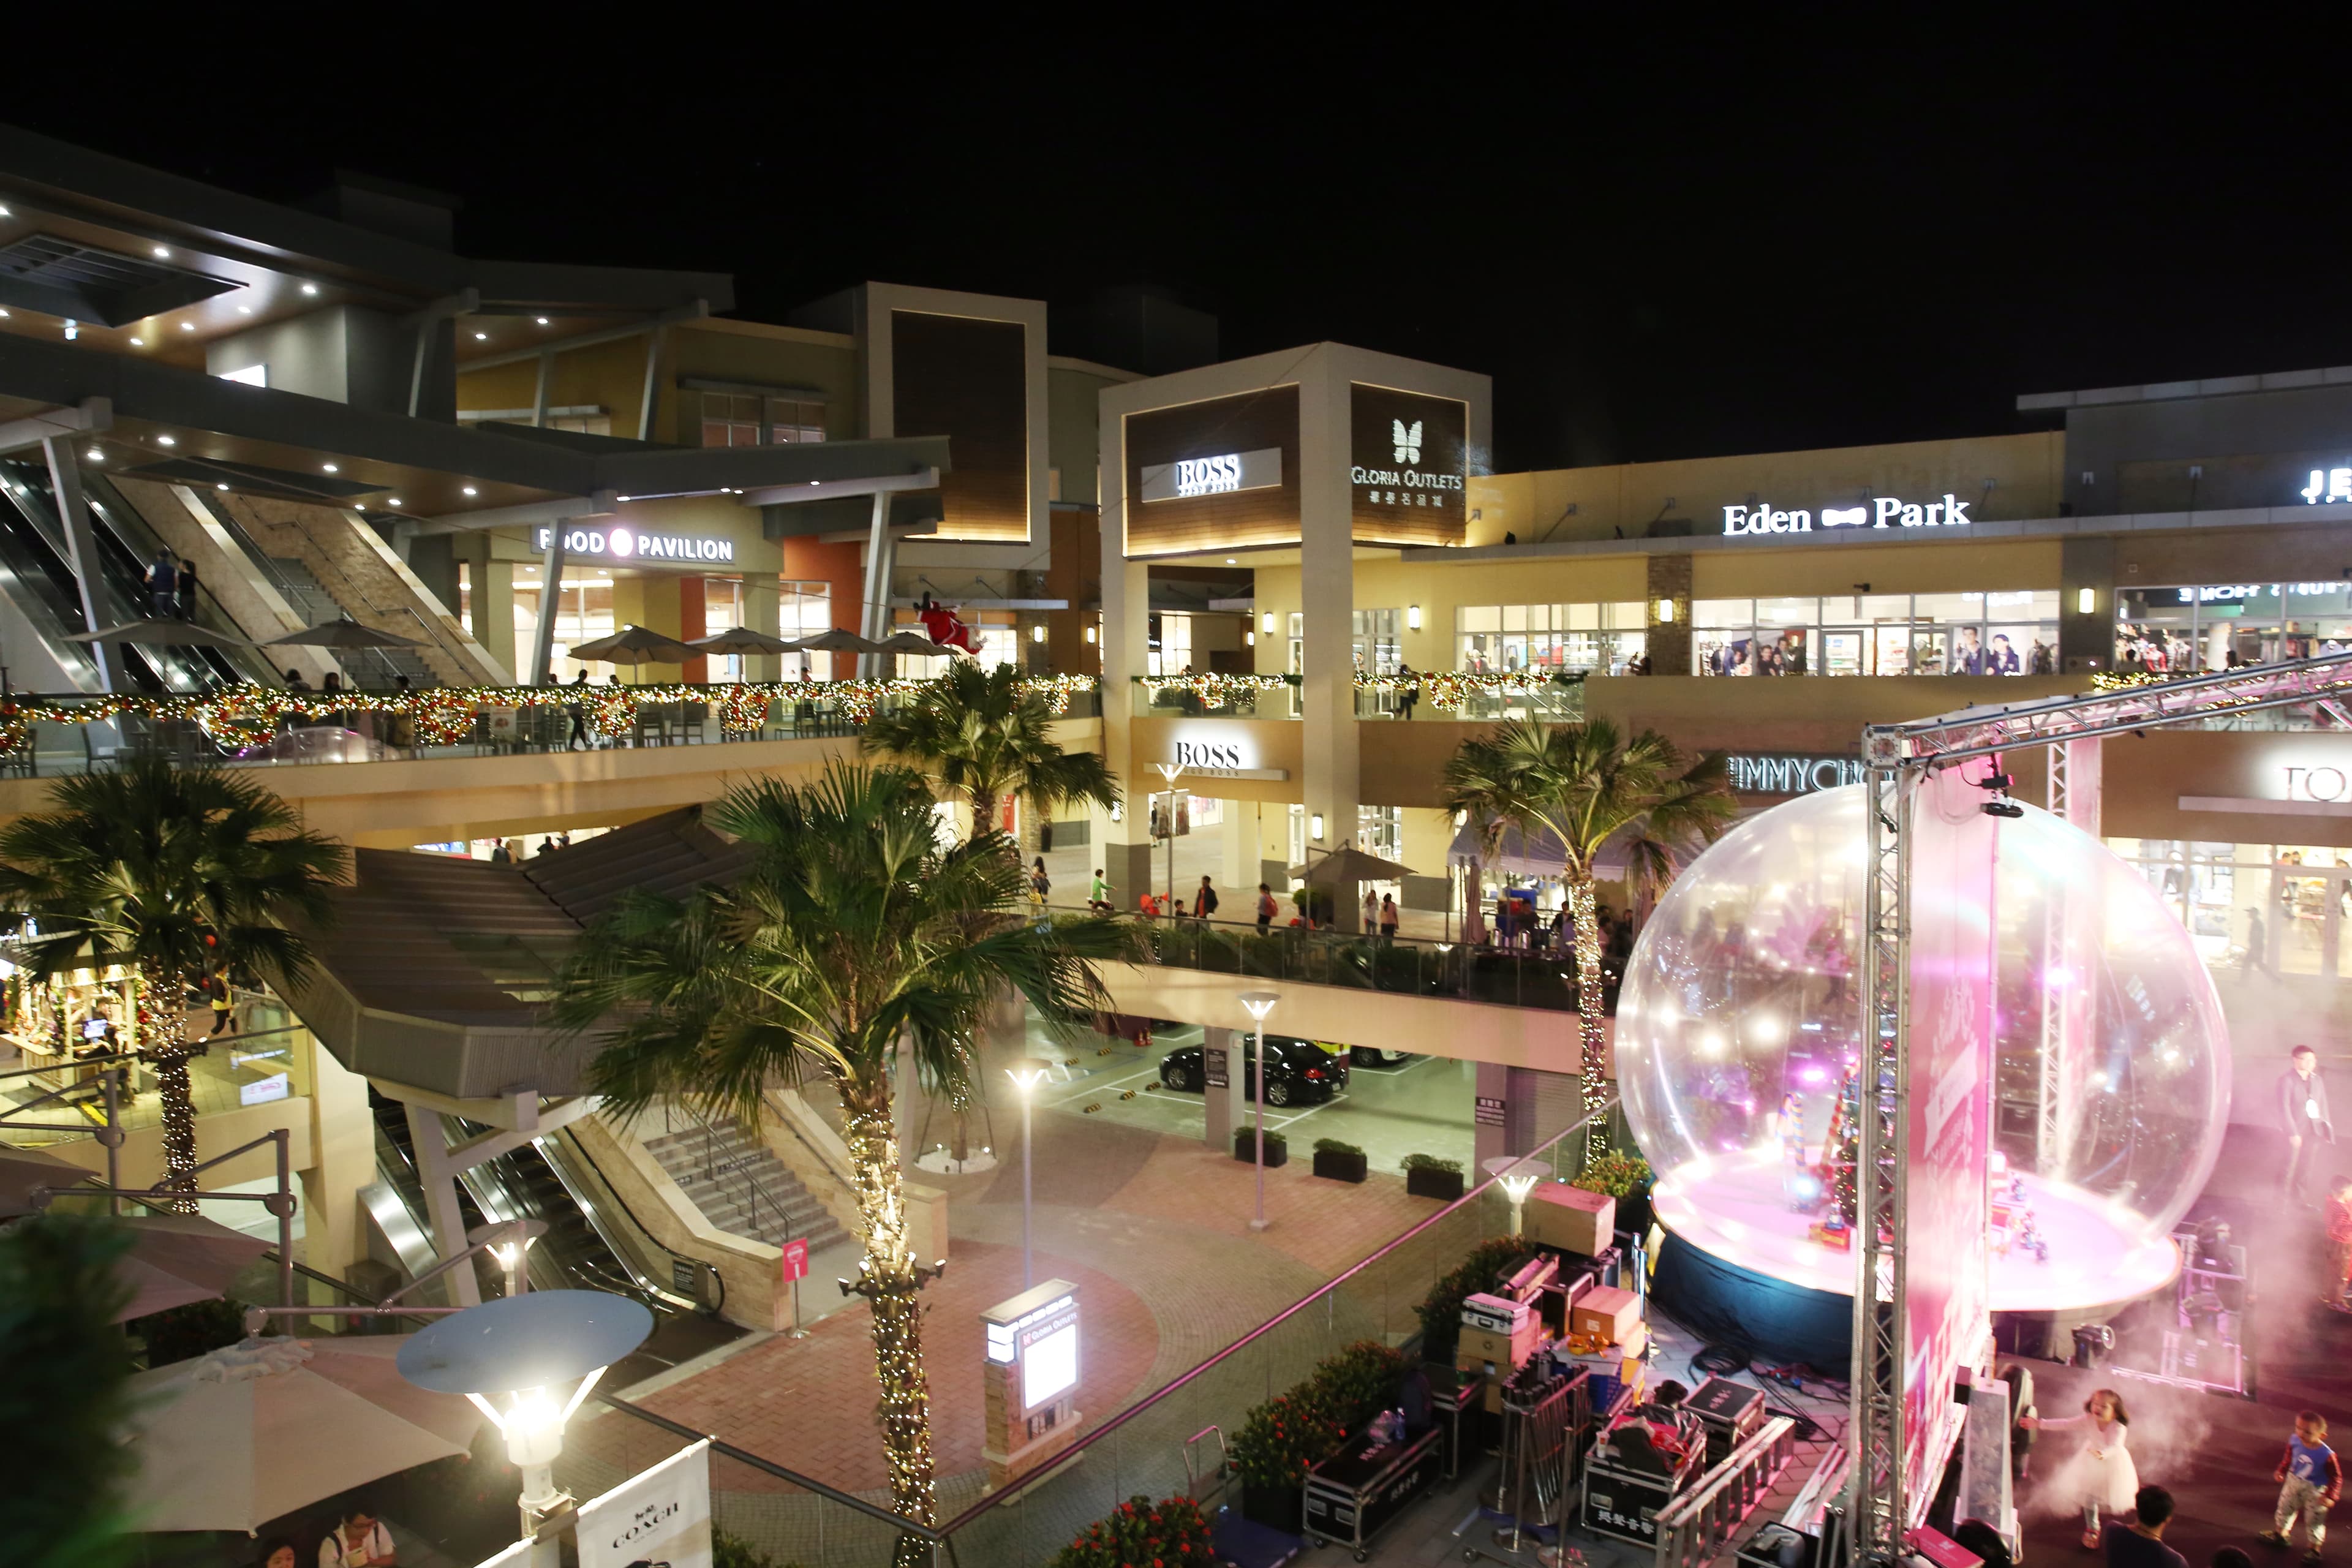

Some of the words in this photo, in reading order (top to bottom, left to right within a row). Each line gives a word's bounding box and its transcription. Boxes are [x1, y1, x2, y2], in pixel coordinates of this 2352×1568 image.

[1176, 455, 1240, 488] BOSS
[1351, 466, 1401, 486] GLORIA
[1404, 470, 1462, 489] OUTLETS
[2301, 468, 2352, 497] JE
[1722, 503, 1813, 536] Eden
[1872, 493, 1971, 529] Park
[540, 529, 605, 552] FOD
[638, 535, 733, 560] PAVILION
[1177, 742, 1239, 769] BOSS
[2283, 767, 2352, 802] TO
[613, 1502, 678, 1548] COACH
